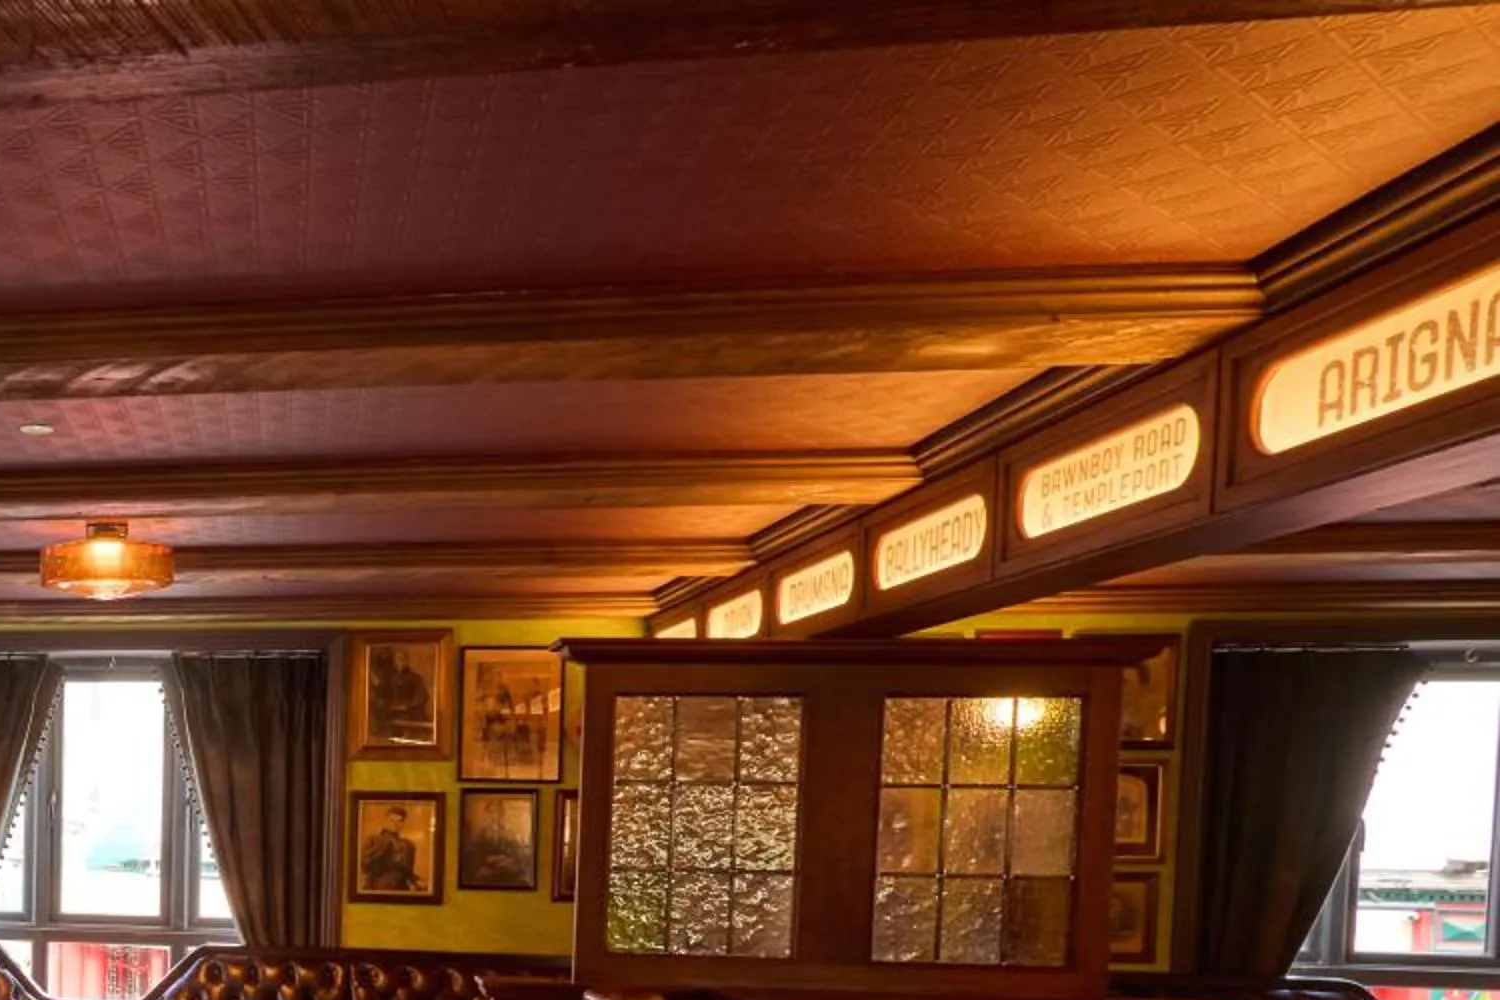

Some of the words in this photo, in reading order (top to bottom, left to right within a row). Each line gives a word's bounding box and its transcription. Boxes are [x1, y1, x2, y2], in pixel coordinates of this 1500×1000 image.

[1041, 443, 1125, 499] BAWNBOY
[1133, 417, 1187, 461] ROAD
[1062, 453, 1184, 522] TEMPLEPORT
[885, 507, 985, 583] BALLYHEADY
